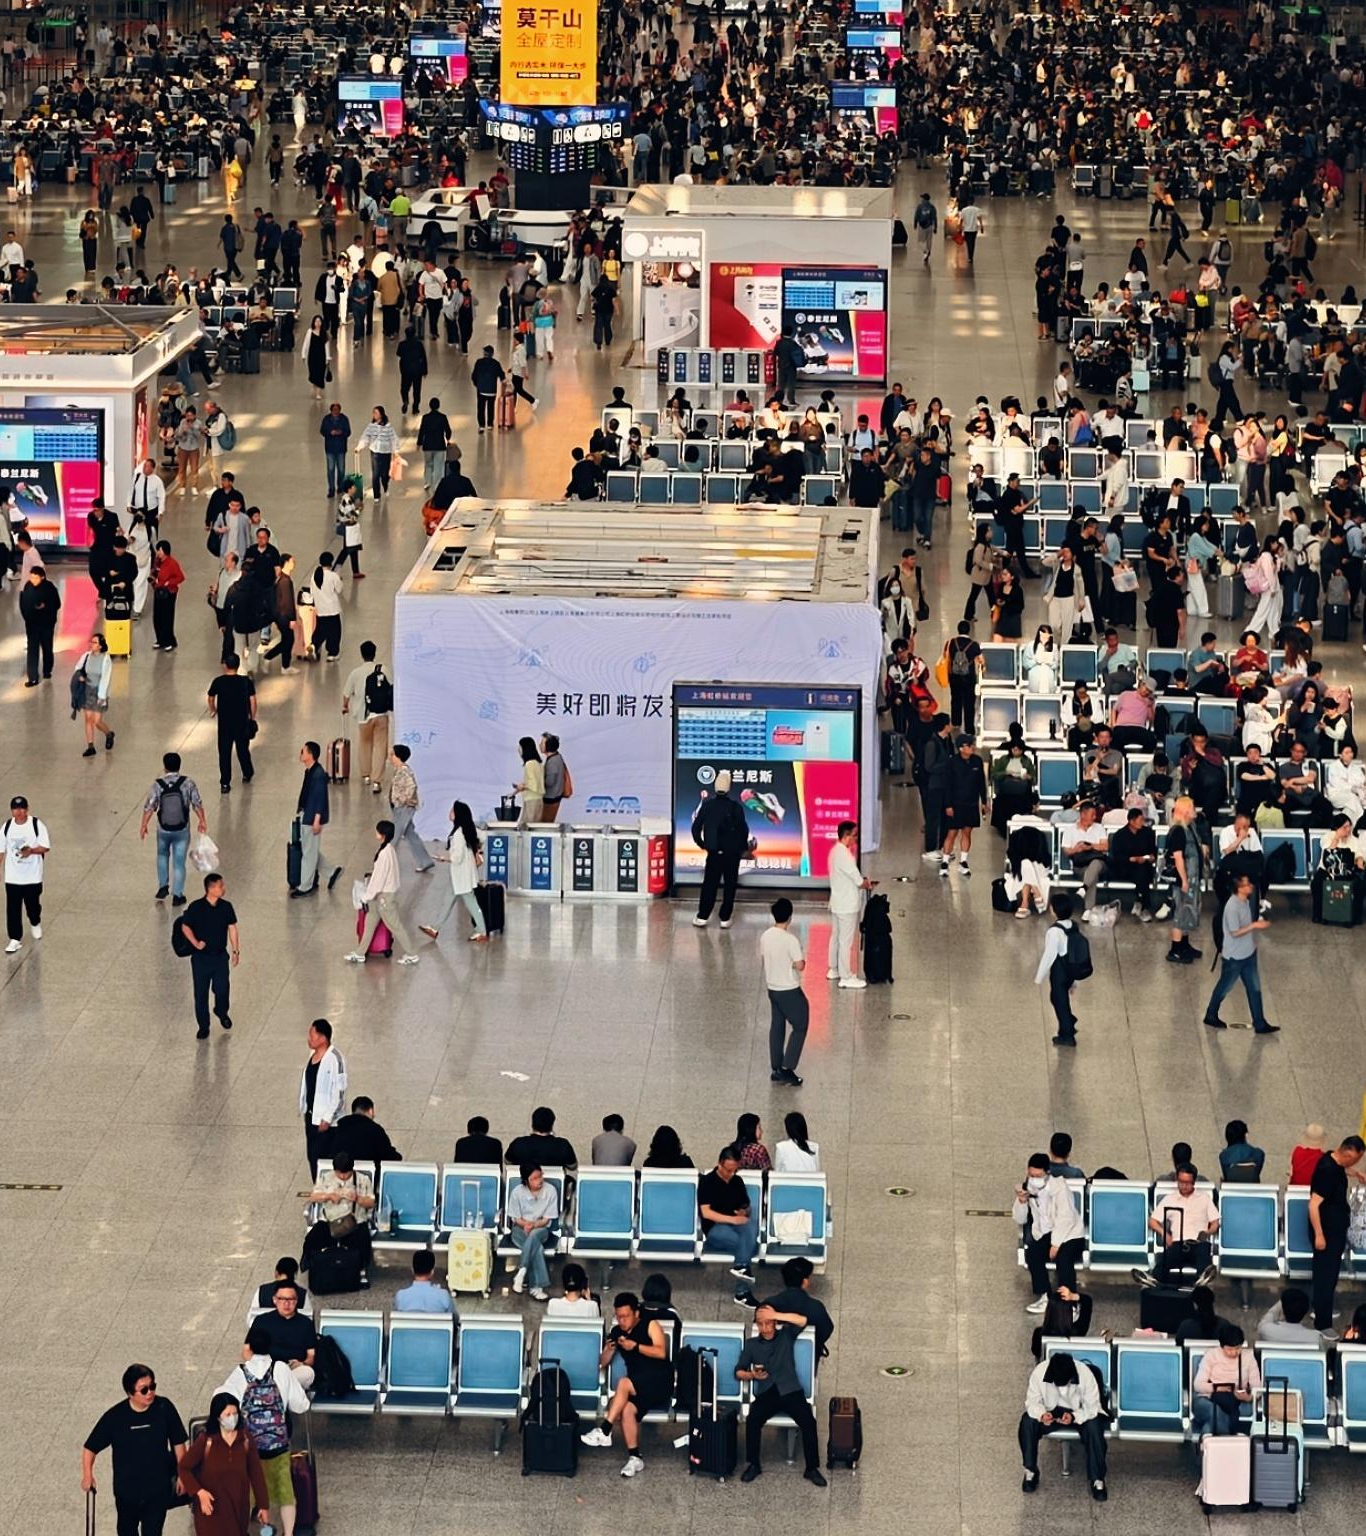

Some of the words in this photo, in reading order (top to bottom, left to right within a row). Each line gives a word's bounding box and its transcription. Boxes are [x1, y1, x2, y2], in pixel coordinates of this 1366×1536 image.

[516, 8, 582, 29] 莫干山
[516, 32, 582, 49] 全屋定制
[536, 692, 672, 718] 美好即将发
